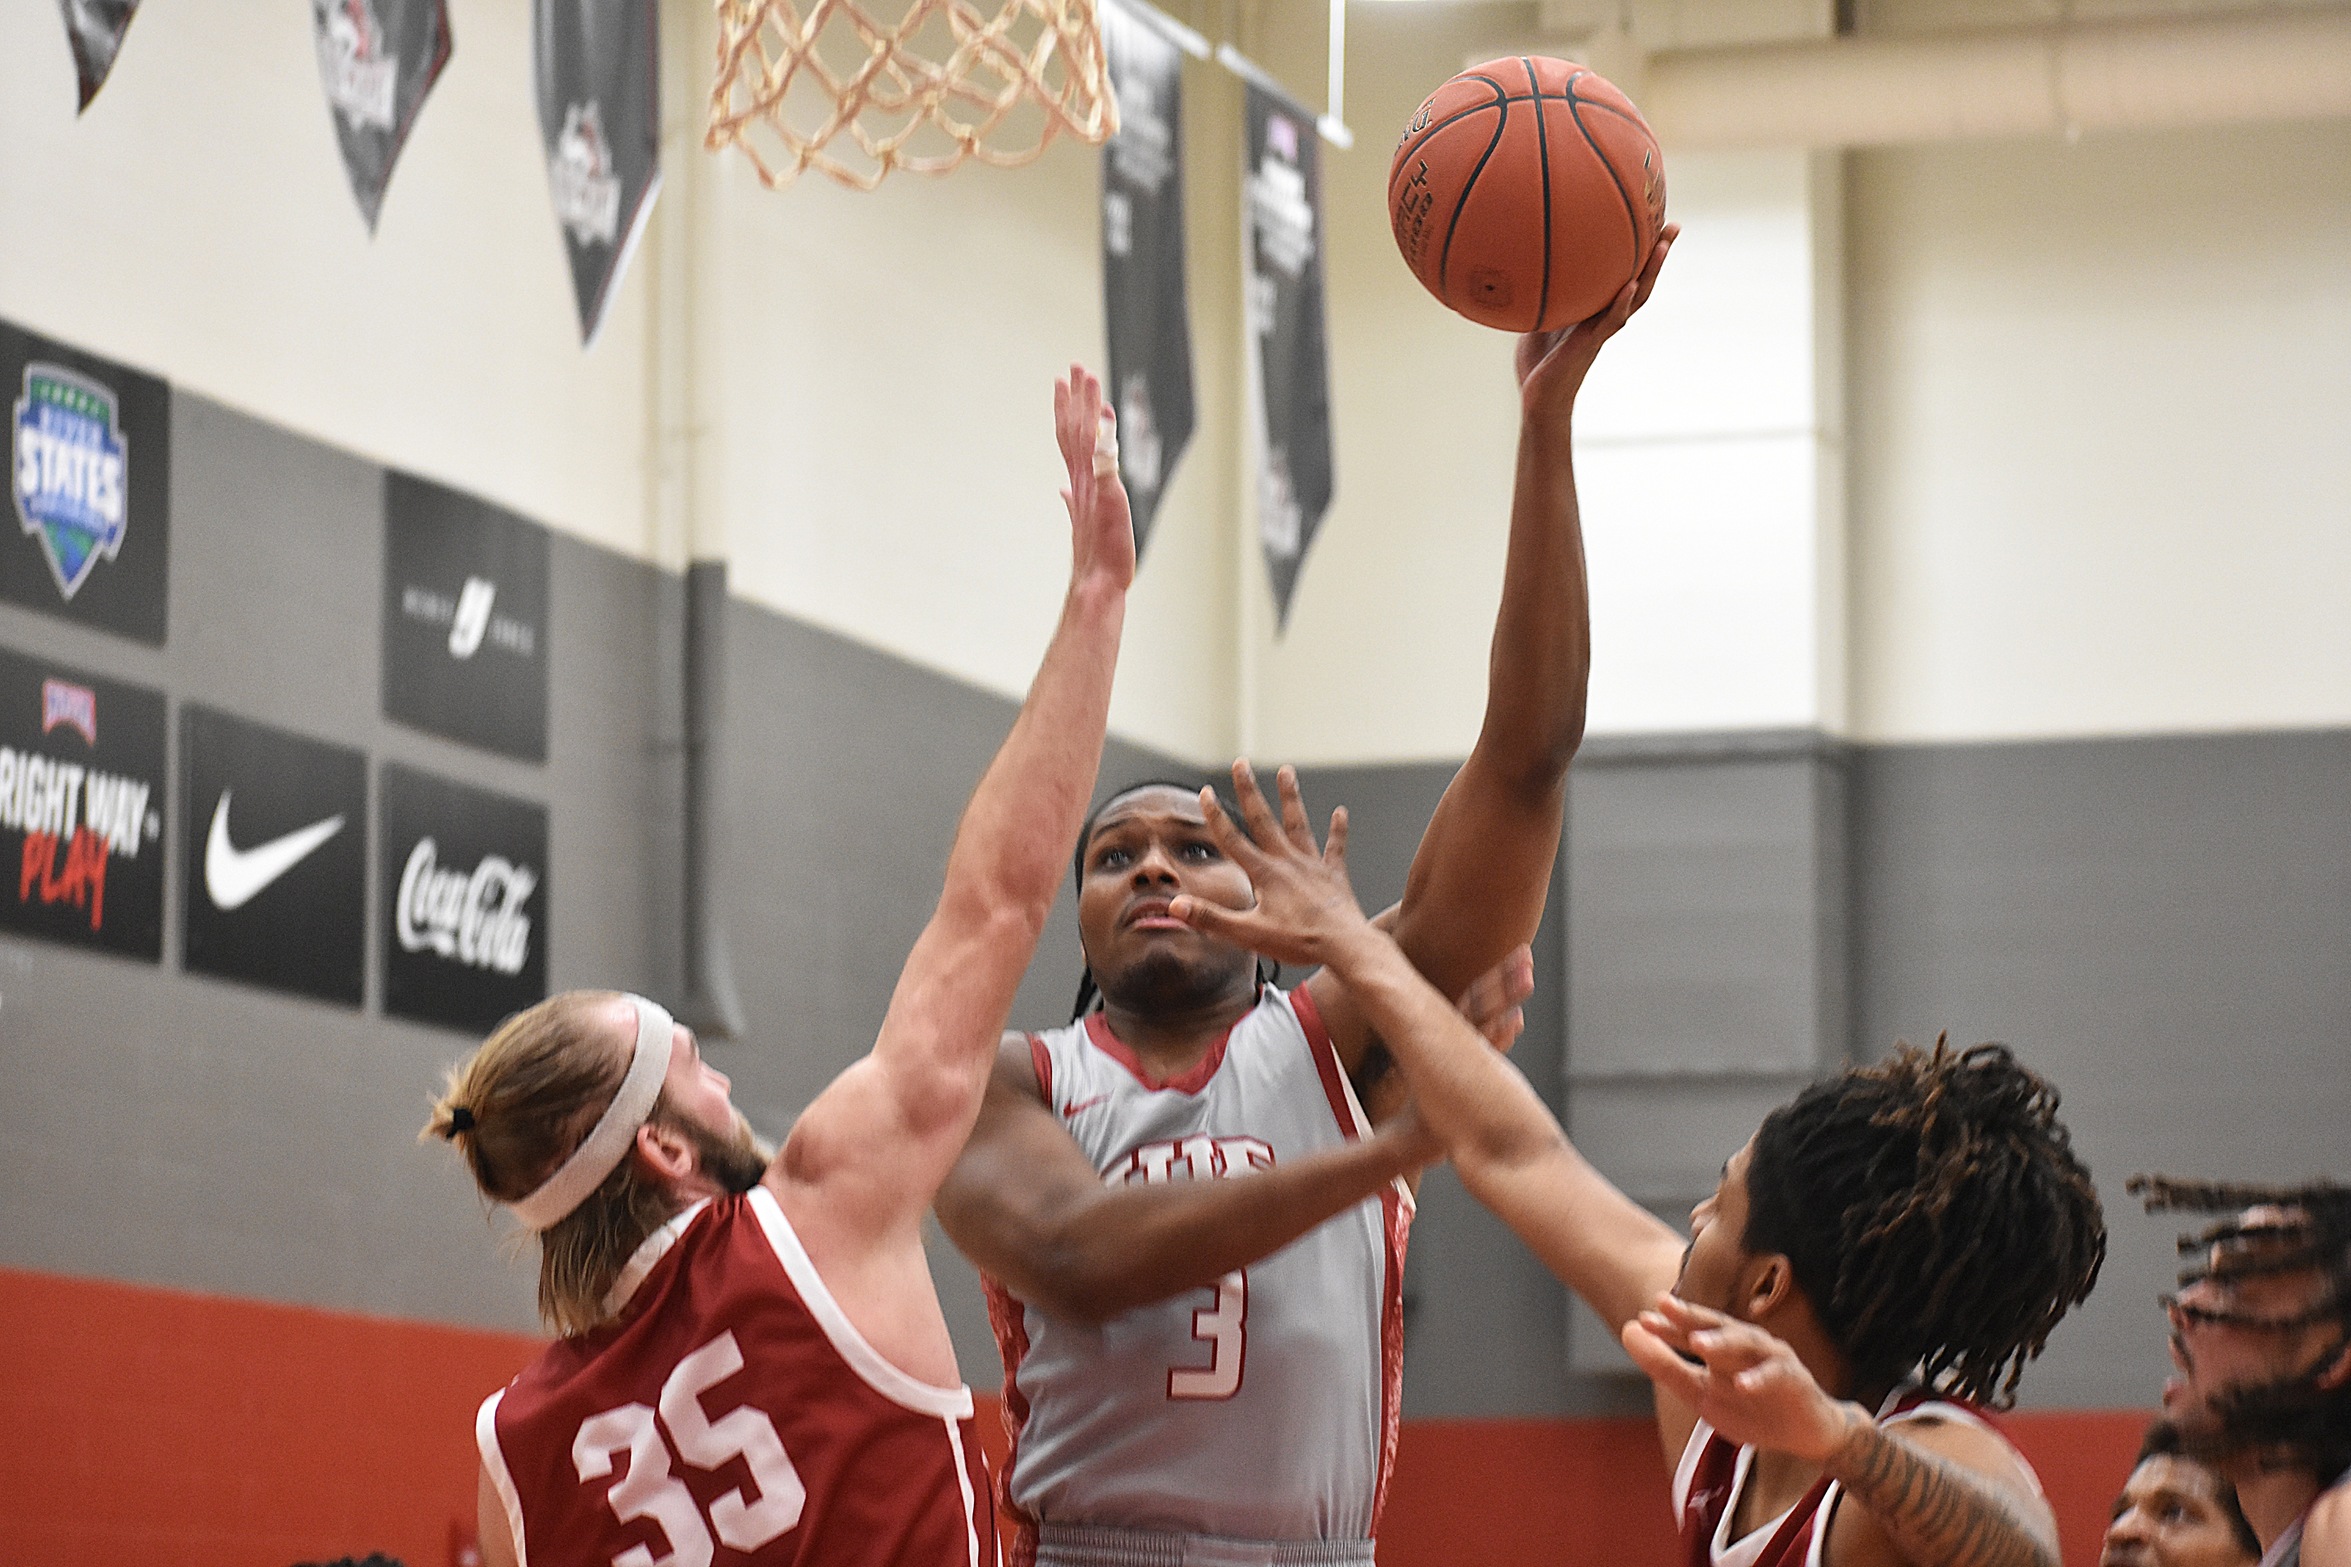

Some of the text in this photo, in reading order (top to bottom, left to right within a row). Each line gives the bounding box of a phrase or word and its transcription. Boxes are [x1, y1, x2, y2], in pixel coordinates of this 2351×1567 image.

[20, 426, 121, 523] STATES
[0, 746, 84, 841] RIGHT
[20, 824, 110, 931] PLAY
[1166, 1266, 1249, 1402] 3
[572, 1328, 804, 1567] 35
